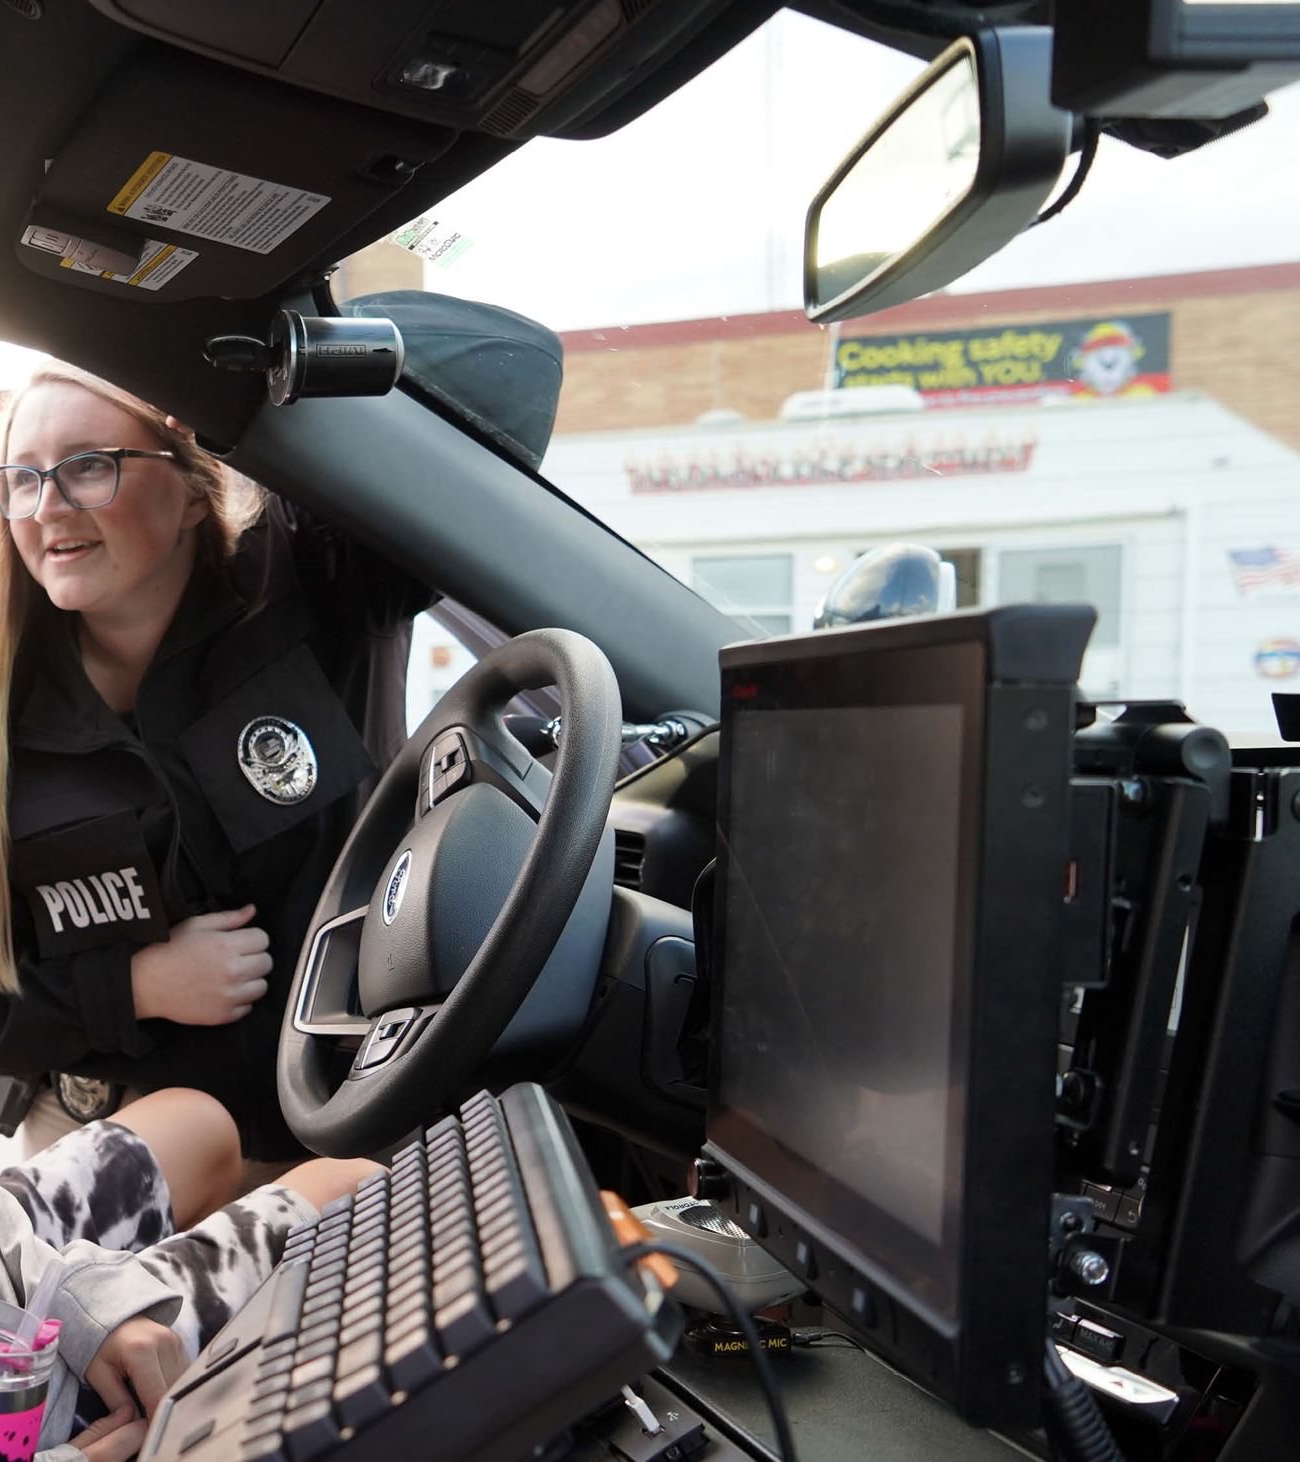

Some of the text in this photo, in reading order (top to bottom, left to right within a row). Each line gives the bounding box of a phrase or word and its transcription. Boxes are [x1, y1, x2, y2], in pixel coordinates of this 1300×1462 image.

[838, 330, 1064, 372] Cooking safety
[917, 364, 978, 389] with
[35, 866, 151, 933] POLICE
[714, 1337, 788, 1352] MAGNC MIC
